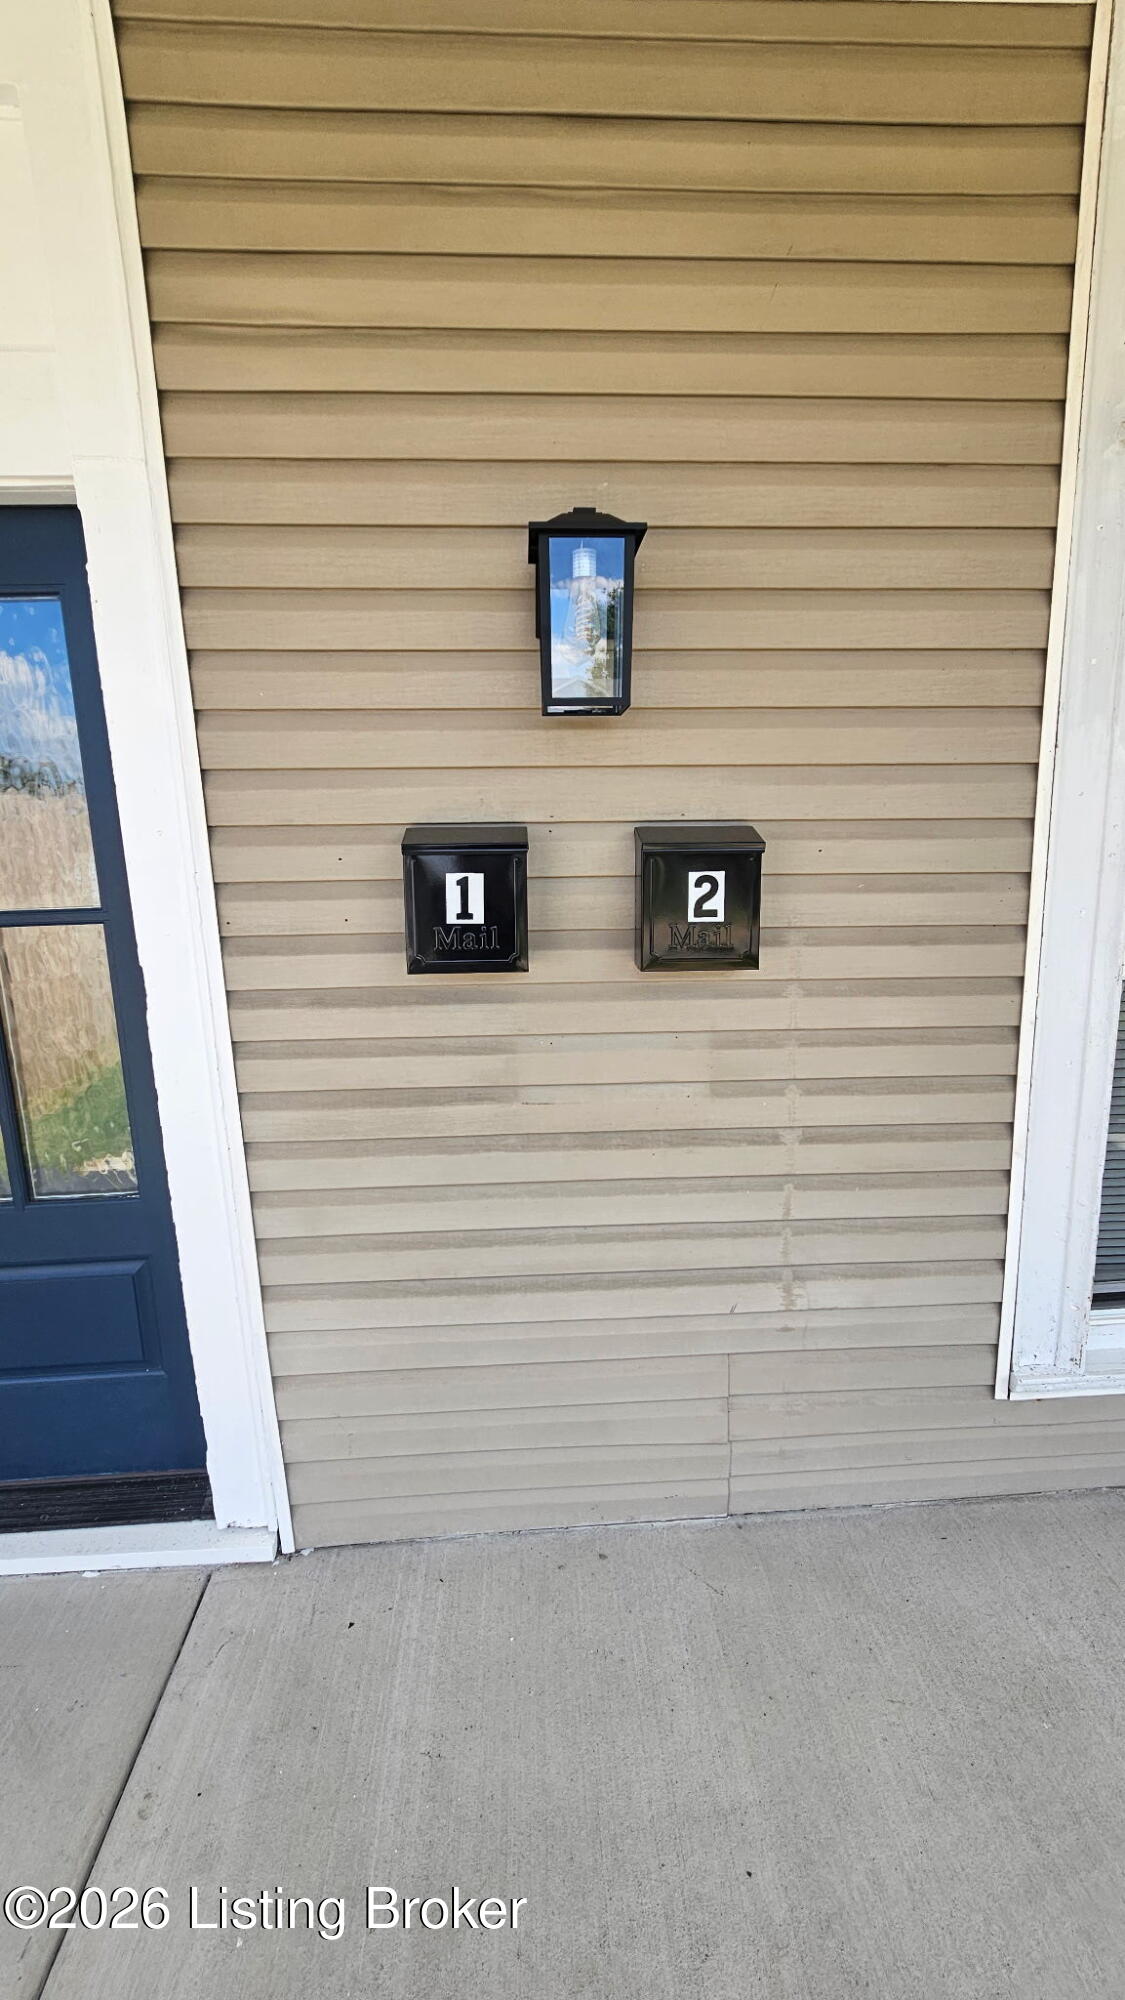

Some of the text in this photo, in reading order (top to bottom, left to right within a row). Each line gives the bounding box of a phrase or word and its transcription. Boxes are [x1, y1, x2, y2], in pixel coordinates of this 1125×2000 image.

[456, 875, 474, 921] 1
[693, 874, 720, 919] 2
[433, 926, 500, 951] Mail
[668, 922, 735, 951] Mail
